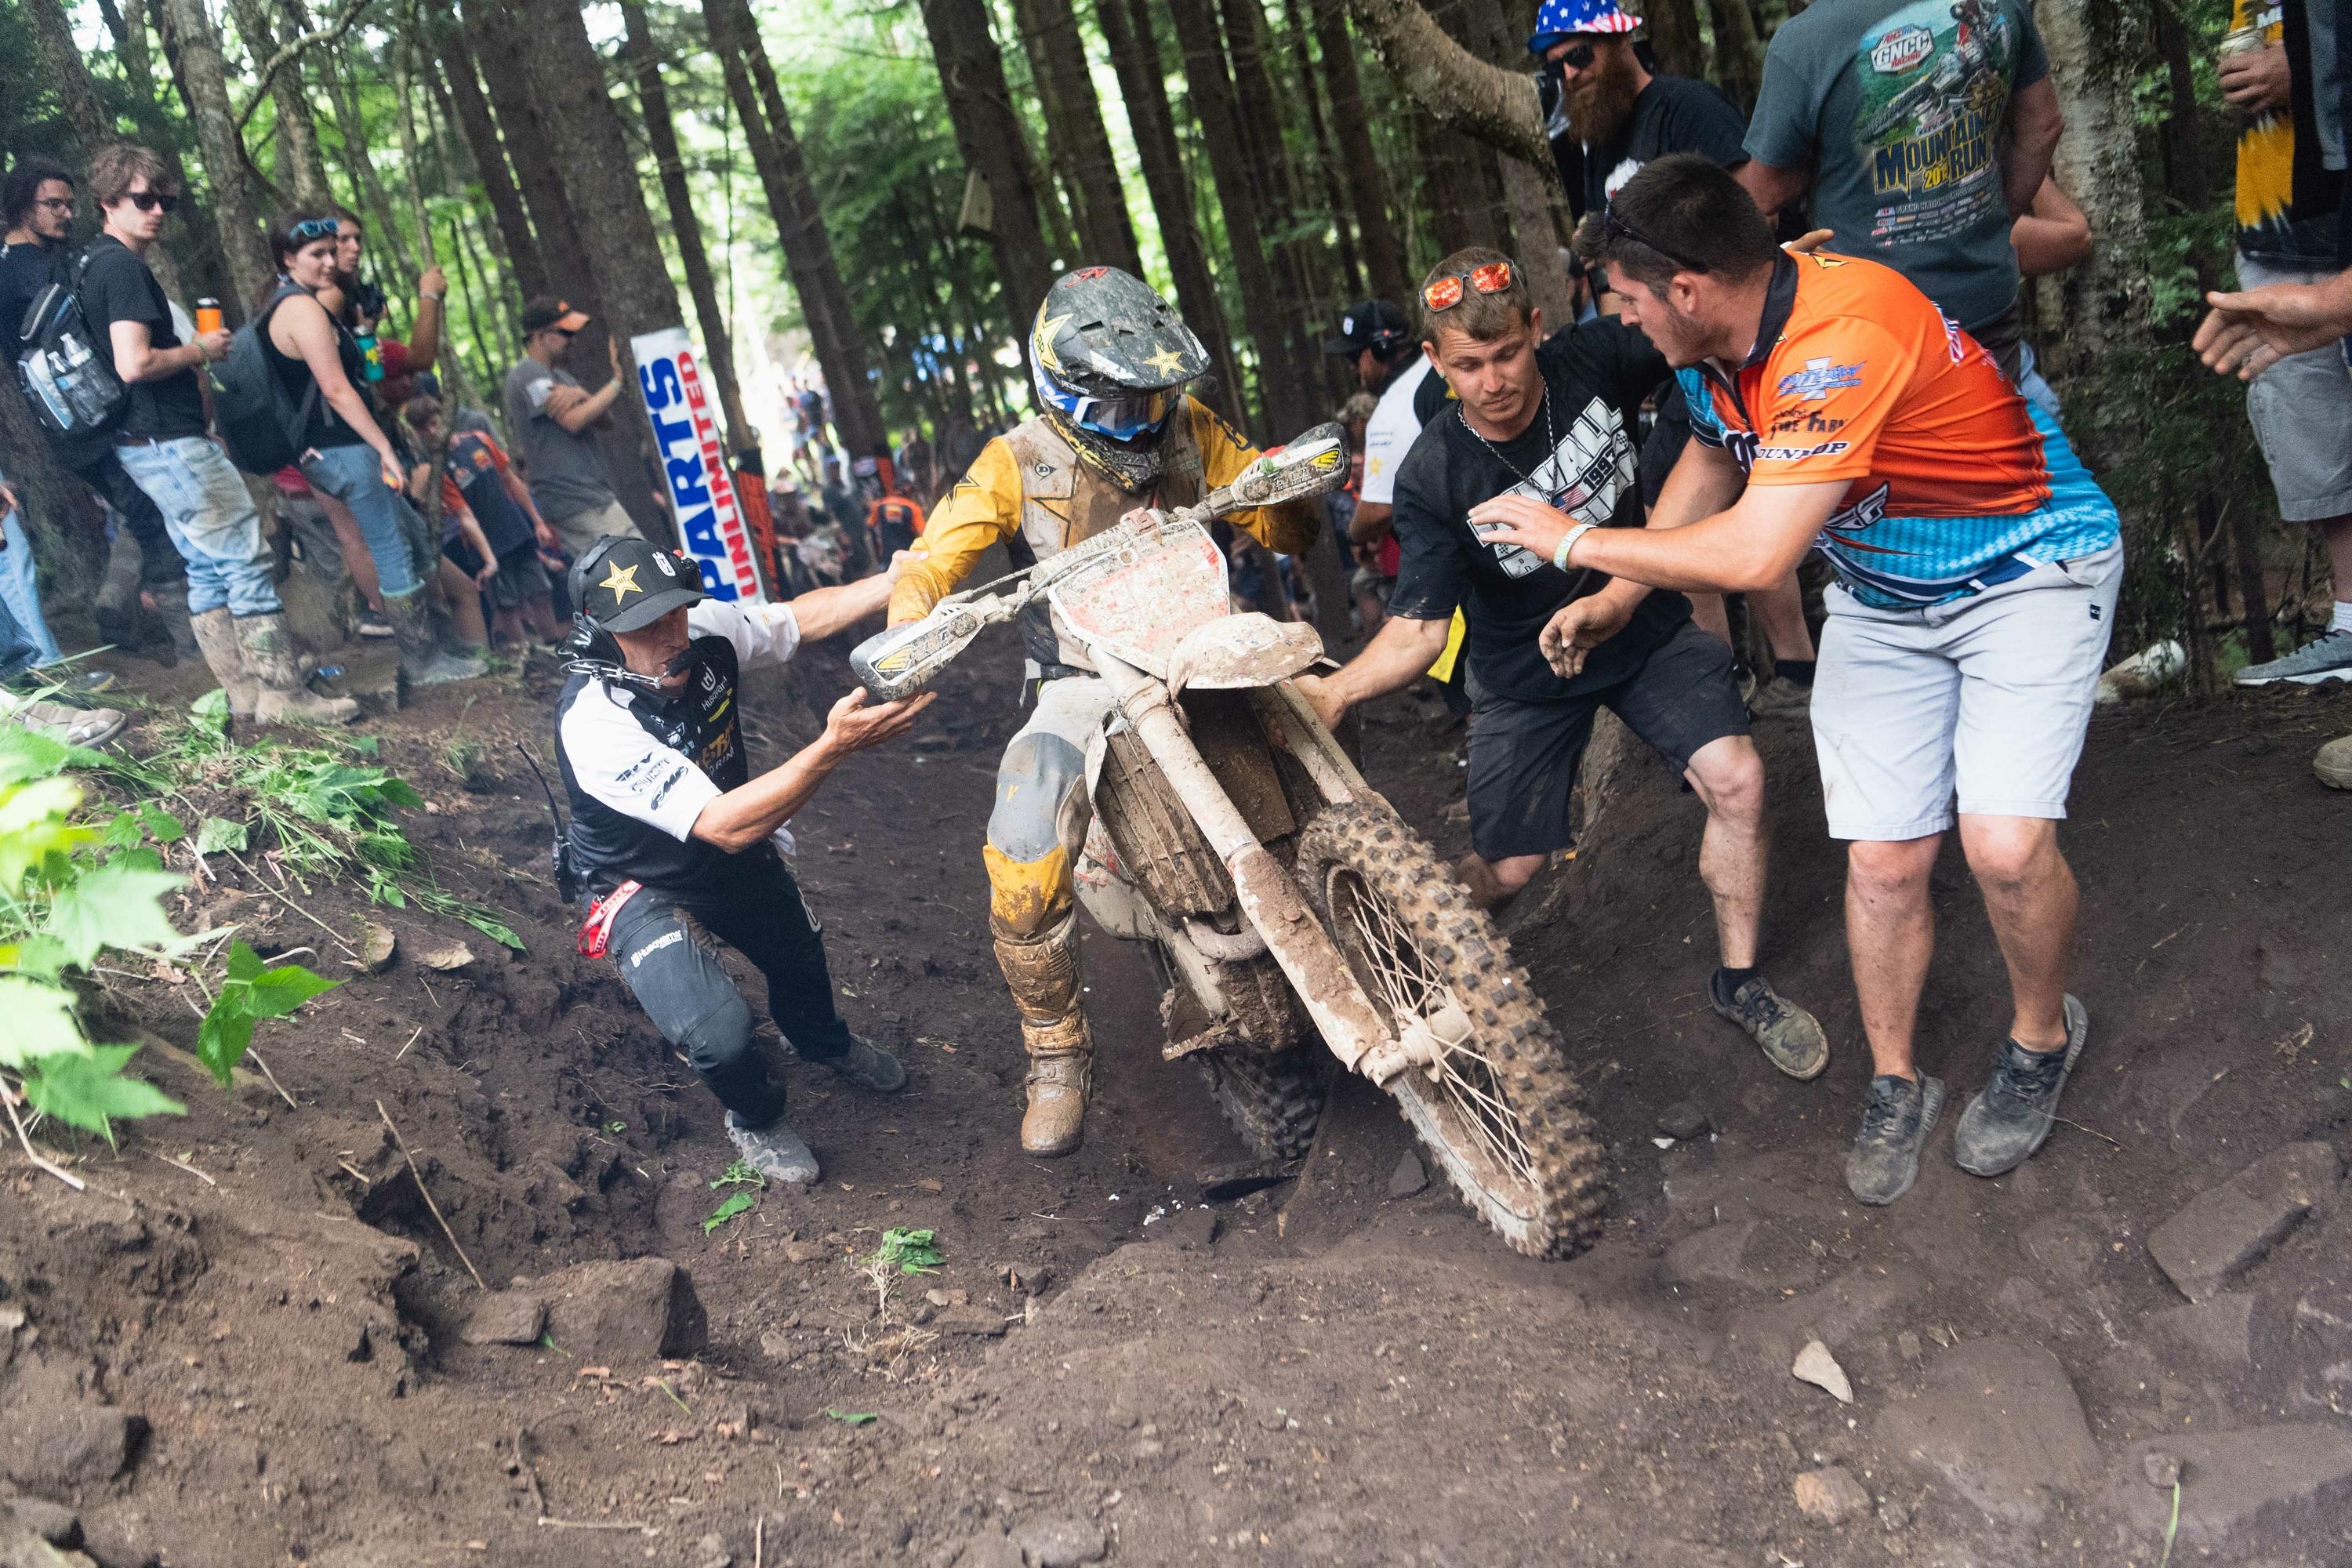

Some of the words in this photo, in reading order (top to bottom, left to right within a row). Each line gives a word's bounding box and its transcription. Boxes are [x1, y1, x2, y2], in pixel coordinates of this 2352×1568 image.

[1875, 34, 1929, 66] GNCC
[1874, 109, 1987, 196] MOUNTAIN
[1949, 135, 1988, 186] RUN
[639, 357, 739, 604] PARTS
[677, 351, 758, 597] UNLIMITED
